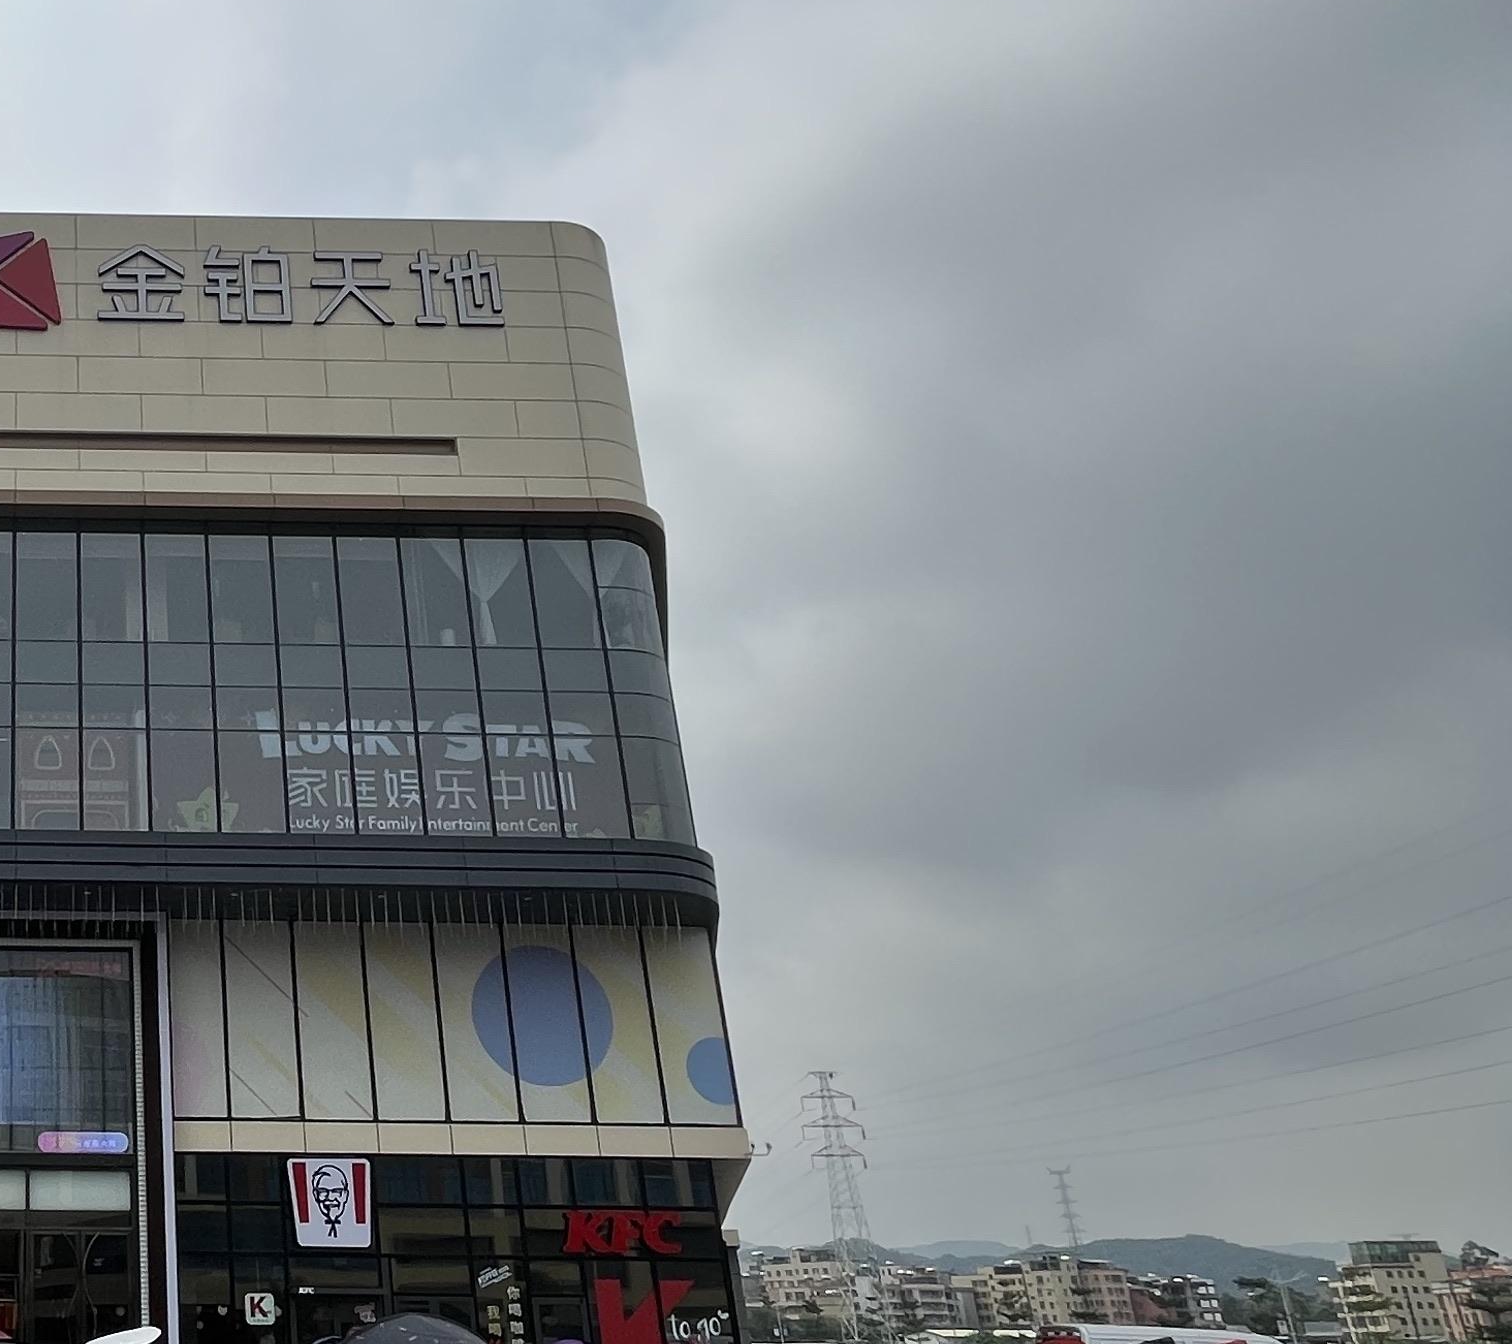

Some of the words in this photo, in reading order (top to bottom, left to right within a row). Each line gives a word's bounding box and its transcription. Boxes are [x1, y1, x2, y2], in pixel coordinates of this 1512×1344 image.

[97, 244, 505, 327] 金铂天地
[287, 766, 577, 812] 家庭娱乐中心
[289, 814, 330, 833] Lucky
[368, 816, 416, 833] Family
[419, 817, 524, 832] ntertainent
[528, 818, 579, 833] Cener
[563, 1210, 683, 1254] KFC
